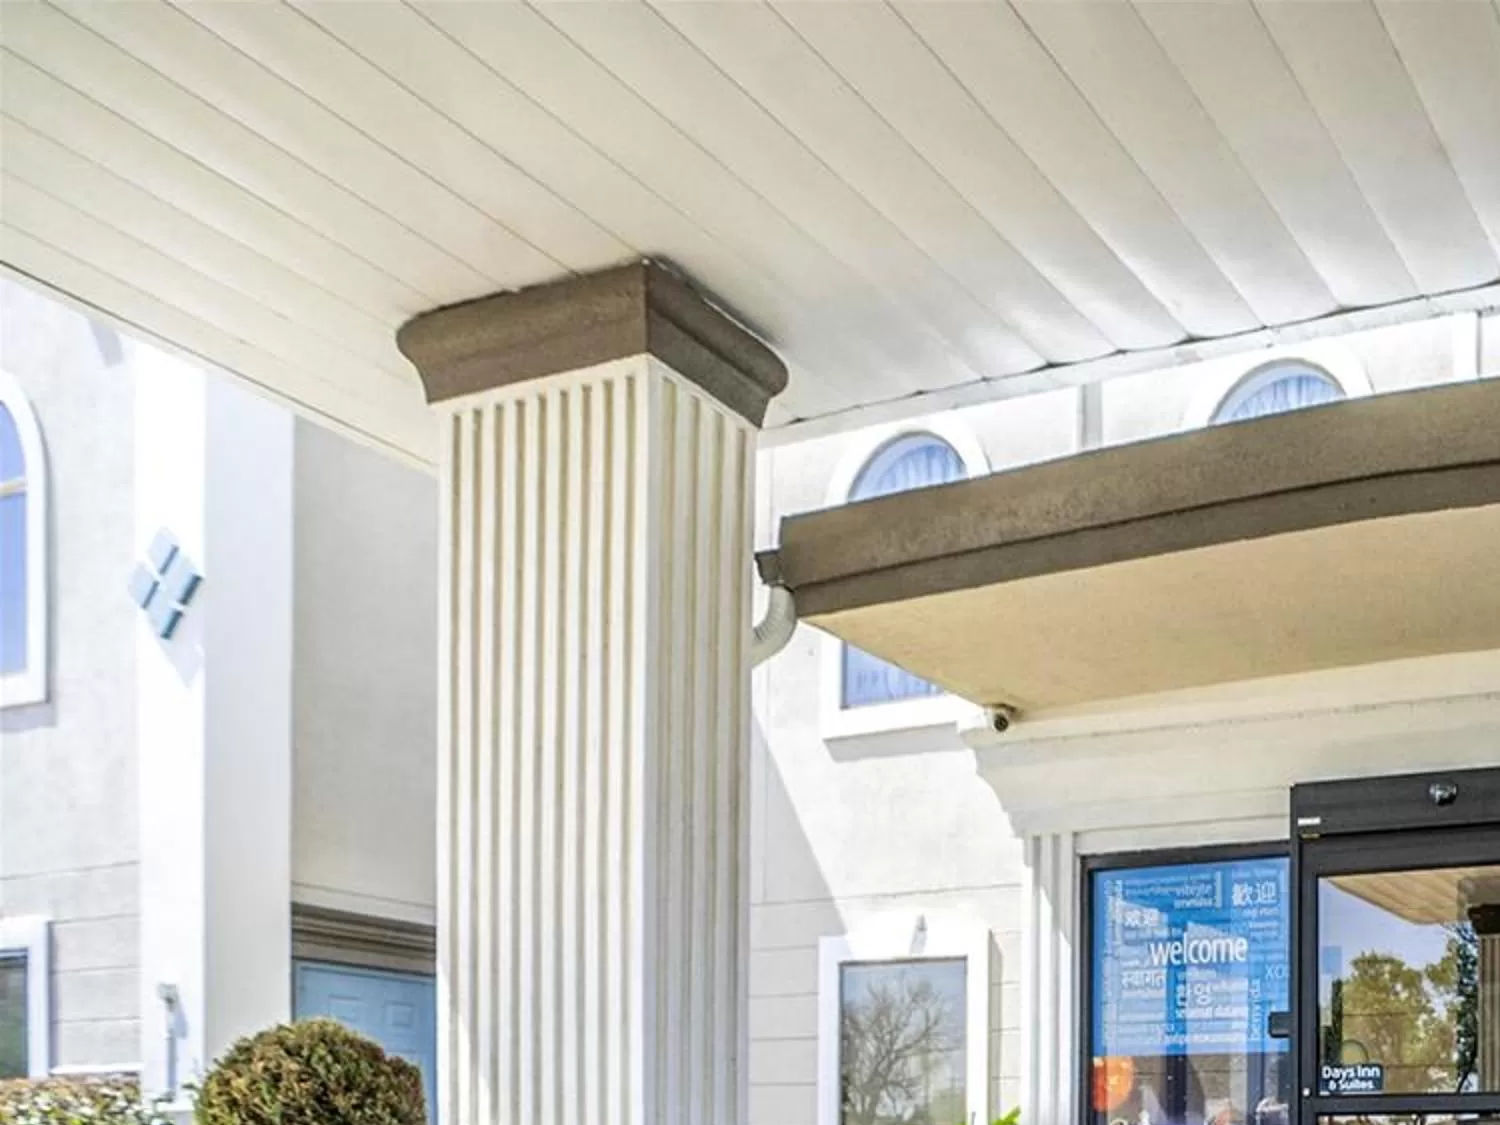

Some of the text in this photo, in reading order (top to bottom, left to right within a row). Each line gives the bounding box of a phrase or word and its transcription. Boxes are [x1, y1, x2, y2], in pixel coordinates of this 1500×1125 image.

[1150, 932, 1249, 966] welcome
[1321, 1064, 1380, 1081] Days Inn
